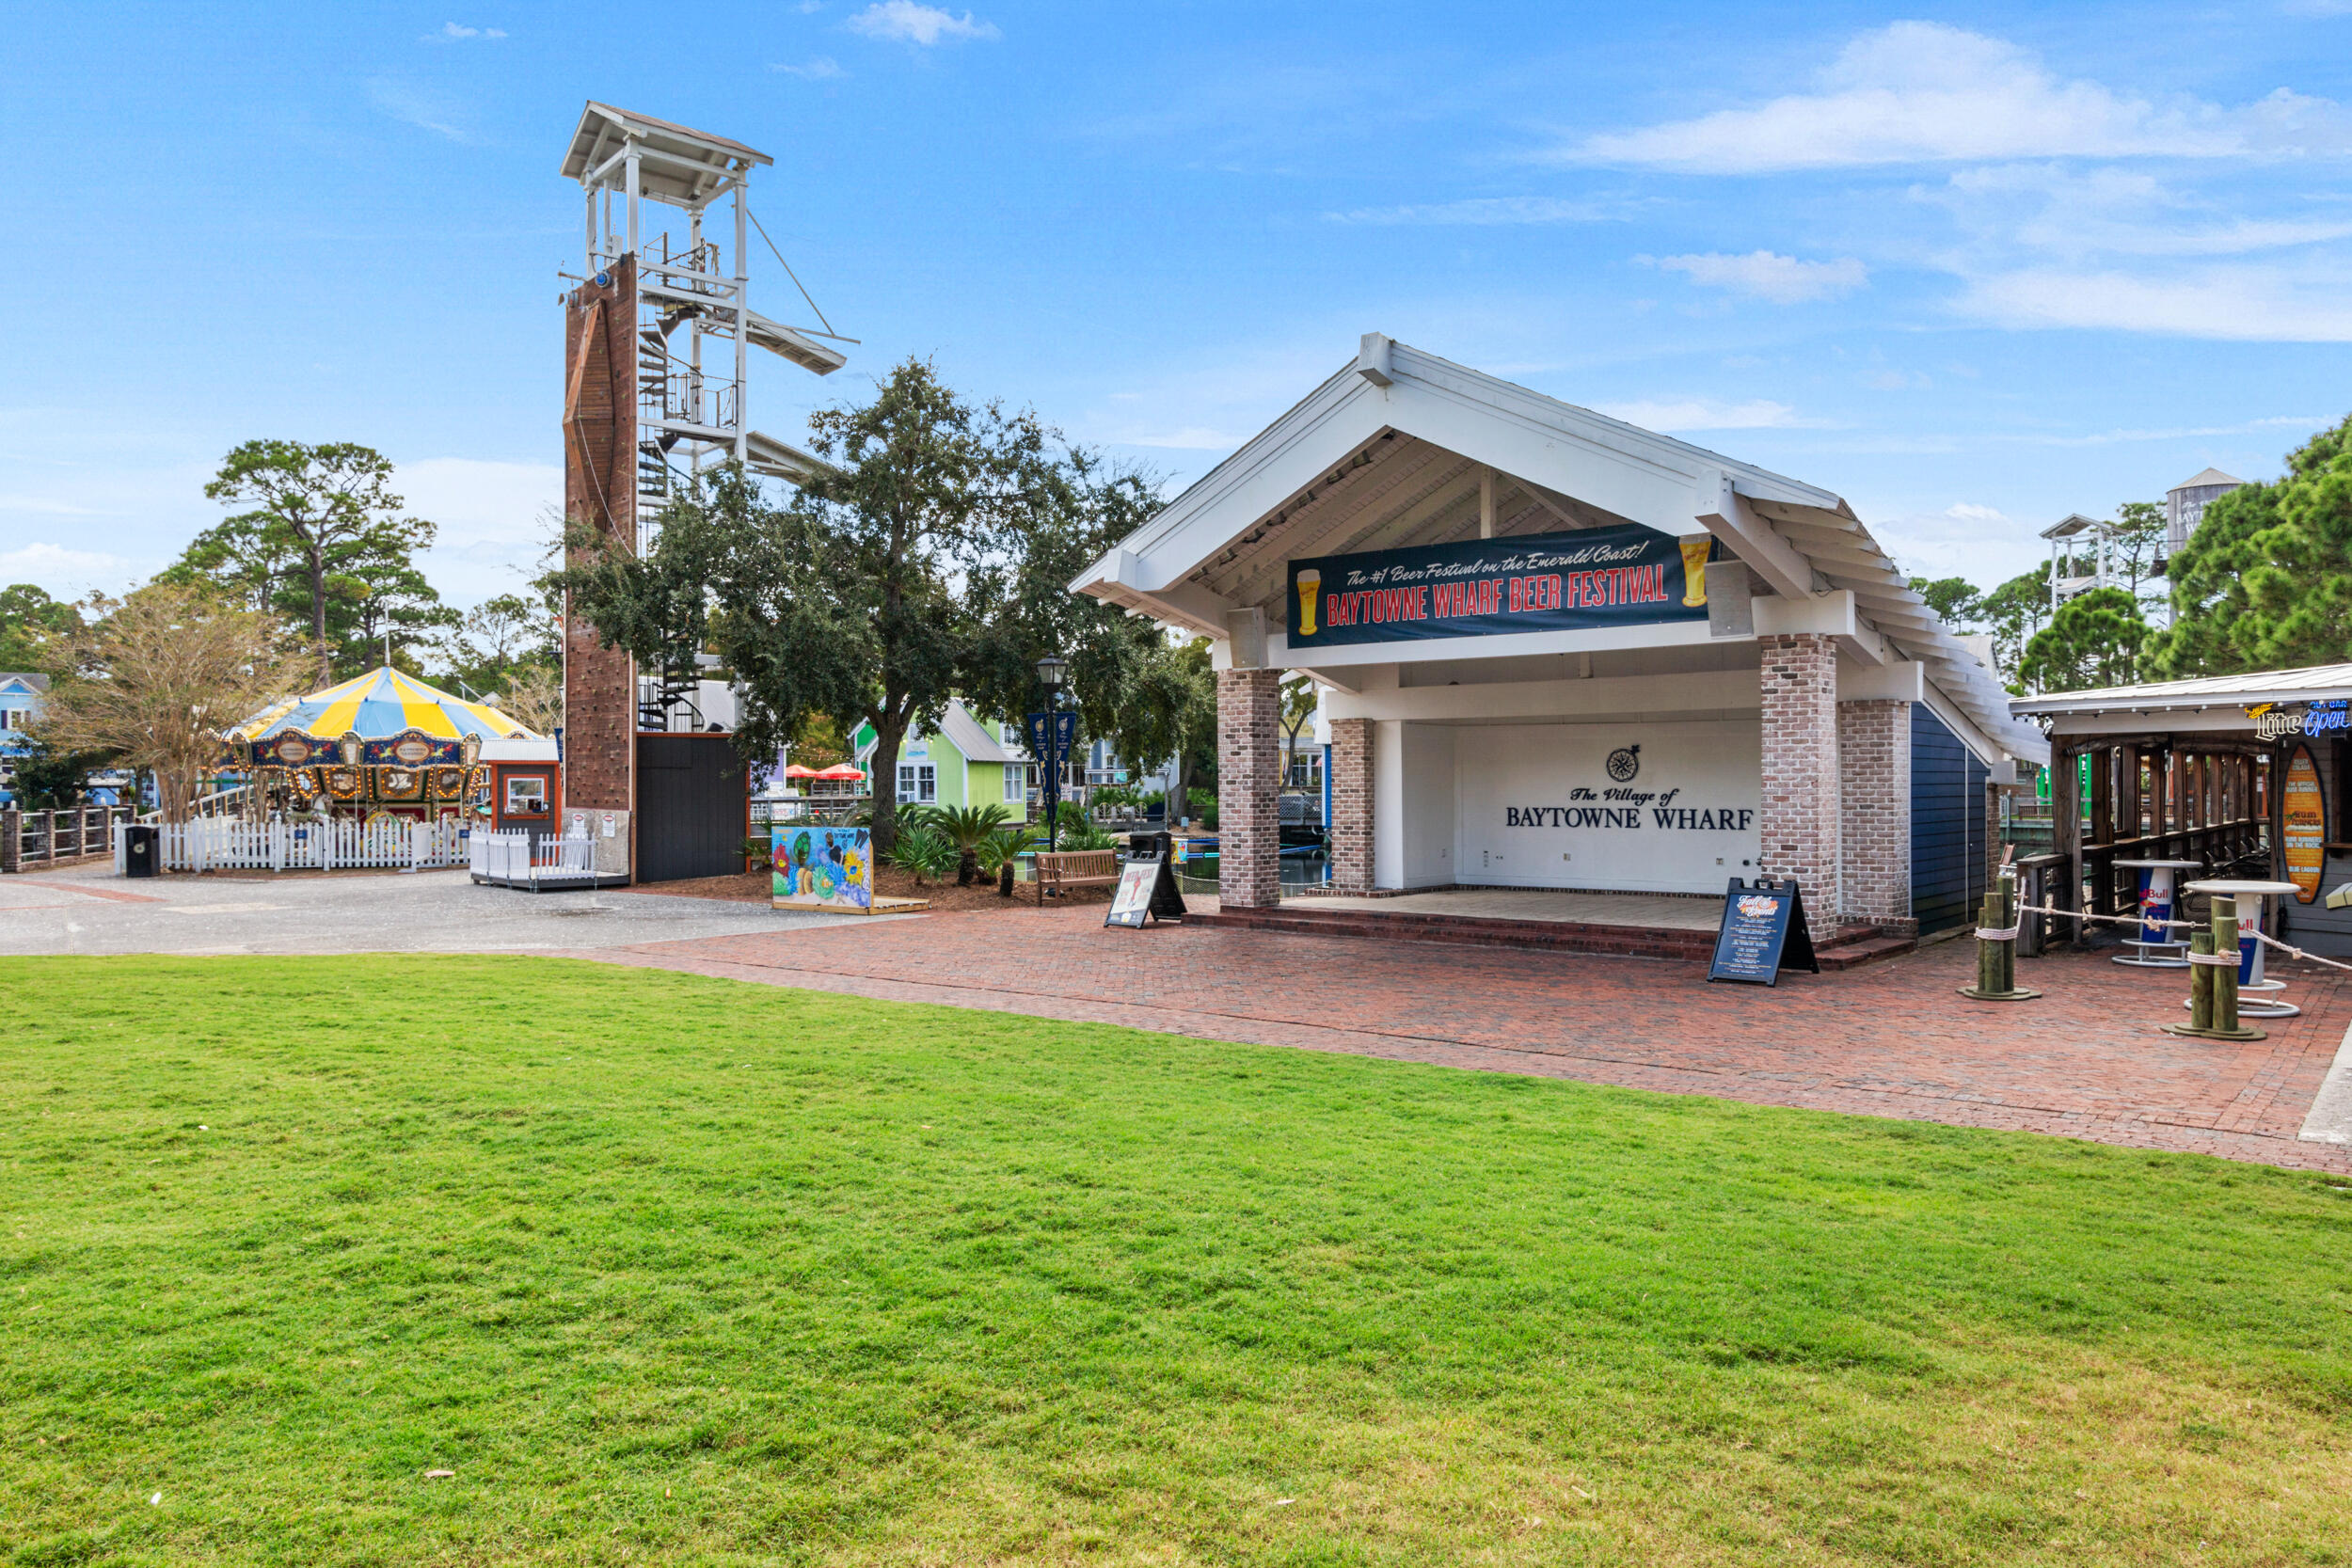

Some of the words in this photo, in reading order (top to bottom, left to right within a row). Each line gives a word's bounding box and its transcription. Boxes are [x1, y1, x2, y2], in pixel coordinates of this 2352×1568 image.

[1346, 570, 1369, 586] The
[1370, 566, 1390, 583] #1
[1391, 565, 1425, 581] Beer
[1425, 559, 1484, 578] Festival
[1482, 563, 1502, 573] on
[1501, 555, 1527, 571] the
[1526, 546, 1595, 570] Emerald
[1593, 540, 1650, 562] Coast!
[1327, 585, 1428, 626] BAYTOWNE
[1433, 578, 1504, 619] WHARF
[1508, 573, 1562, 613] BEER
[1567, 563, 1669, 609] FESTIVAL
[2255, 712, 2302, 741] Lite
[2305, 710, 2351, 737] Open
[1569, 788, 1598, 801] The
[1603, 788, 1656, 806] Village
[1659, 788, 1679, 807] of
[1505, 806, 1642, 829] BAYTOWNE
[1652, 808, 1755, 831] WHARF
[2148, 889, 2169, 898] Bull
[2237, 919, 2253, 930] ull
